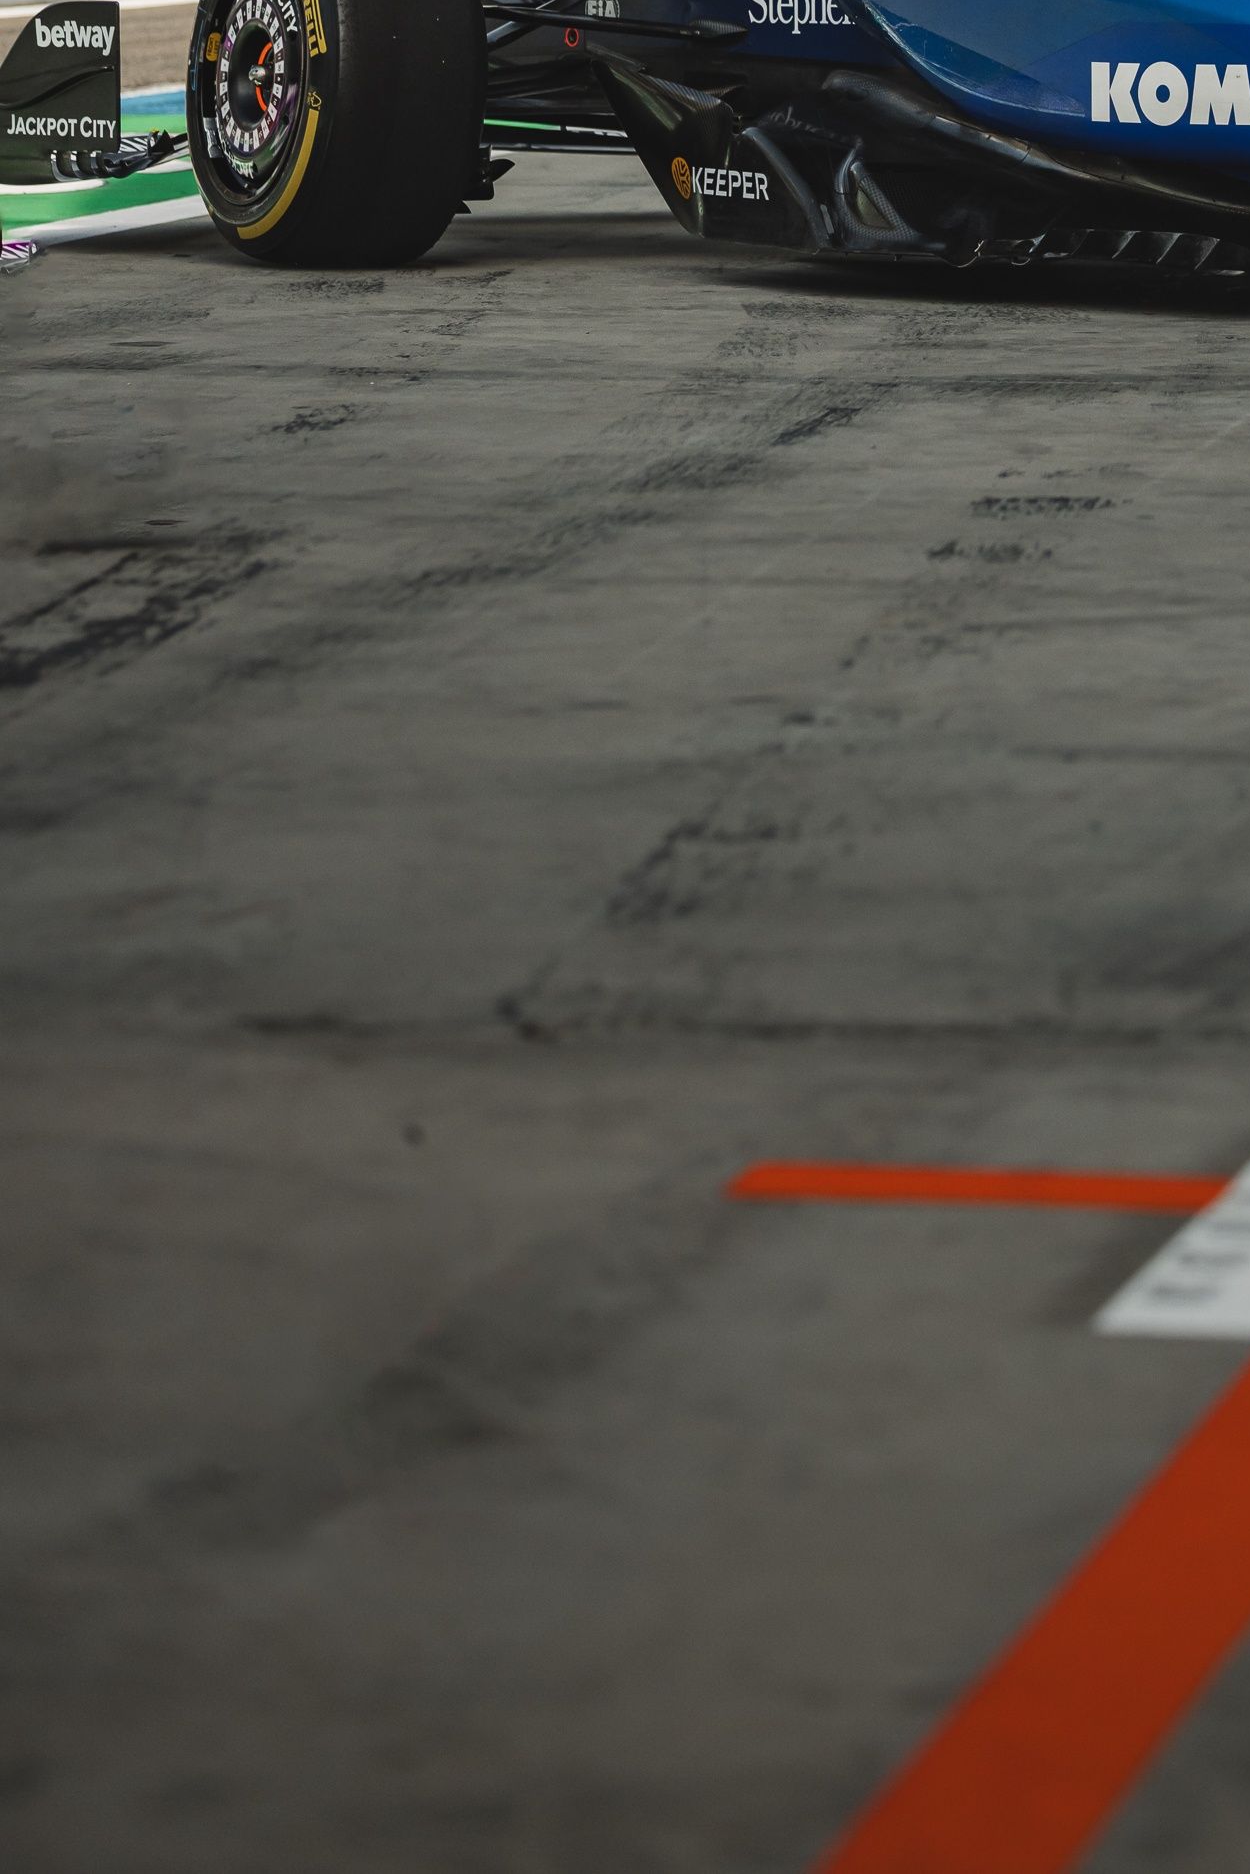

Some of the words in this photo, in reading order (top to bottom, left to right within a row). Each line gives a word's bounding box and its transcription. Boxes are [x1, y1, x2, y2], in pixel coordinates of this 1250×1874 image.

[35, 18, 115, 56] betway
[7, 114, 78, 137] JACKPOT
[80, 116, 116, 139] CITY
[692, 166, 770, 201] KEEPER
